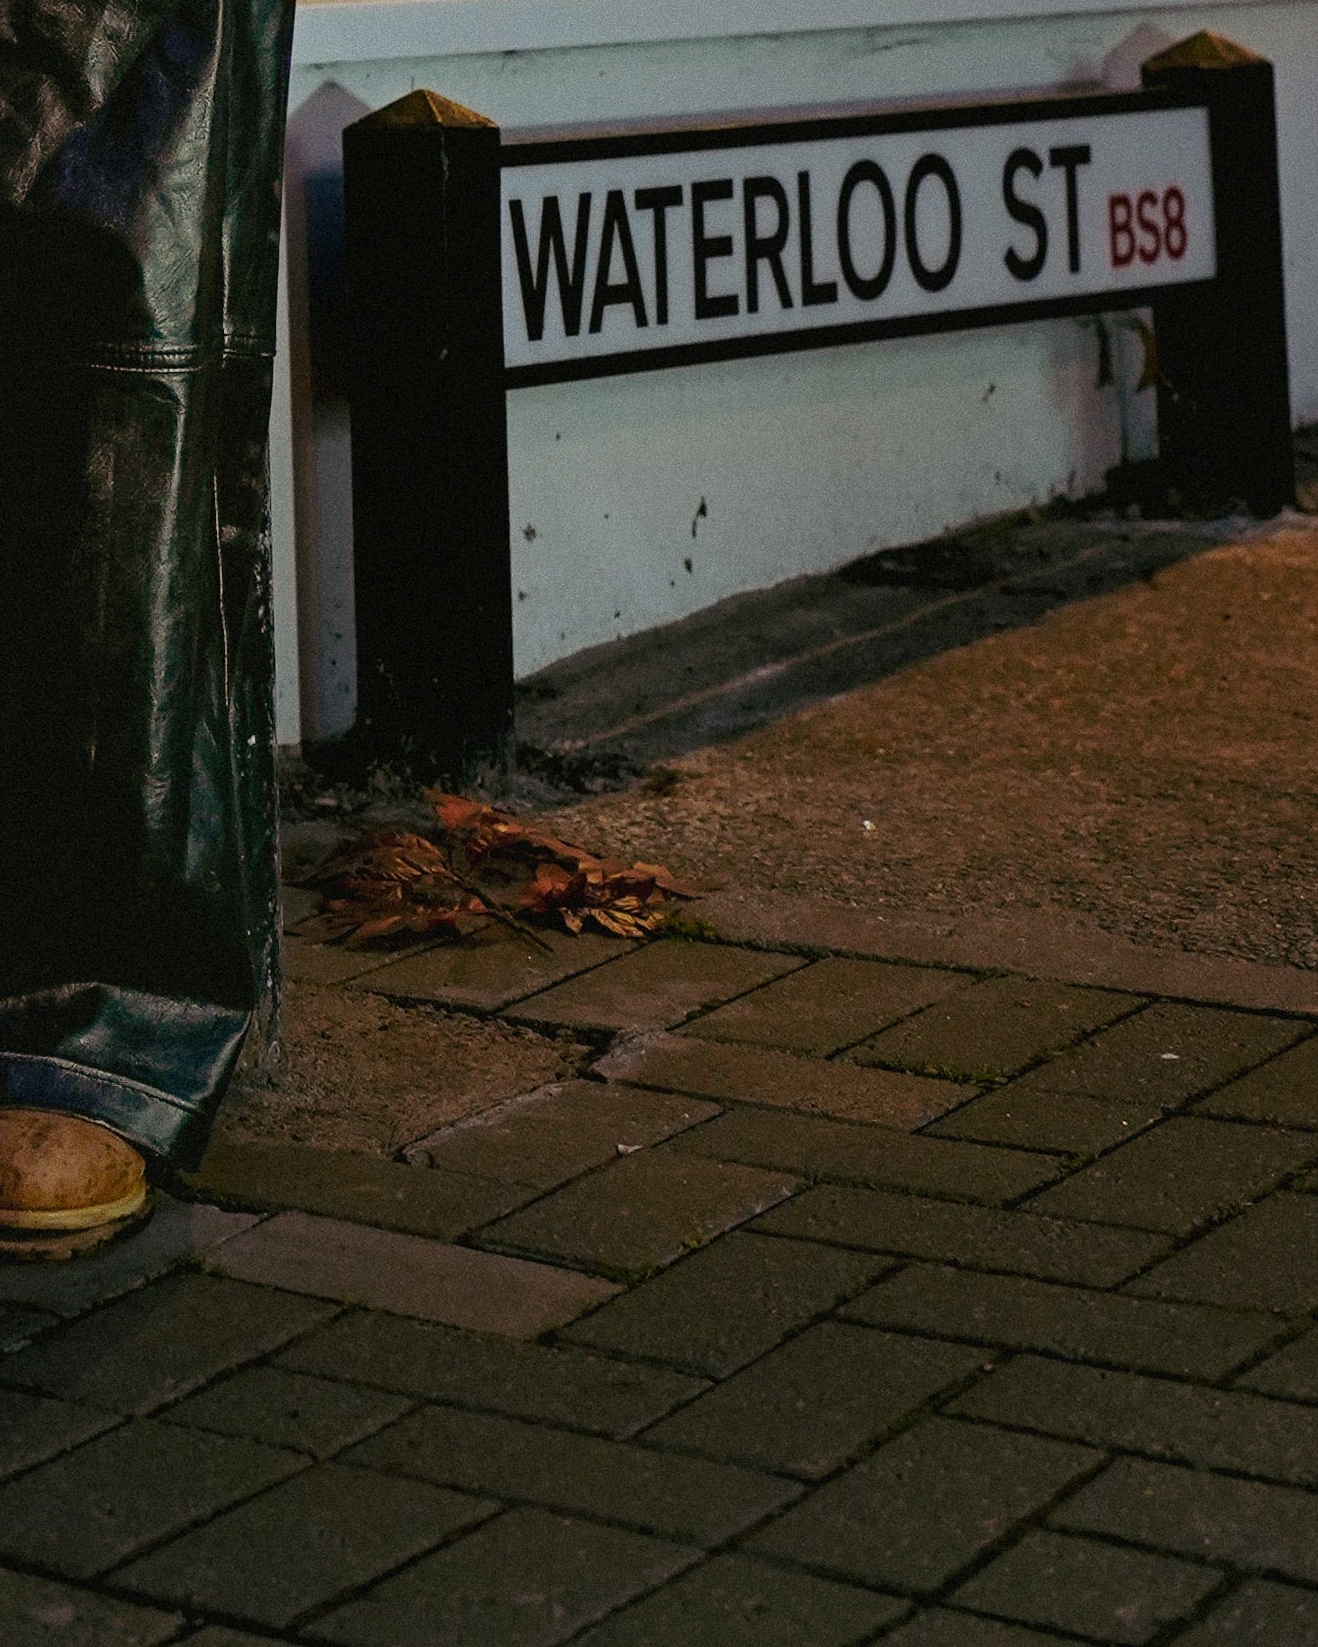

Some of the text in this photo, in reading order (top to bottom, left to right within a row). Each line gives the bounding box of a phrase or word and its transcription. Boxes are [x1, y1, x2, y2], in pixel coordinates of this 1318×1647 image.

[509, 144, 1188, 343] WATERLOO ST BS8
